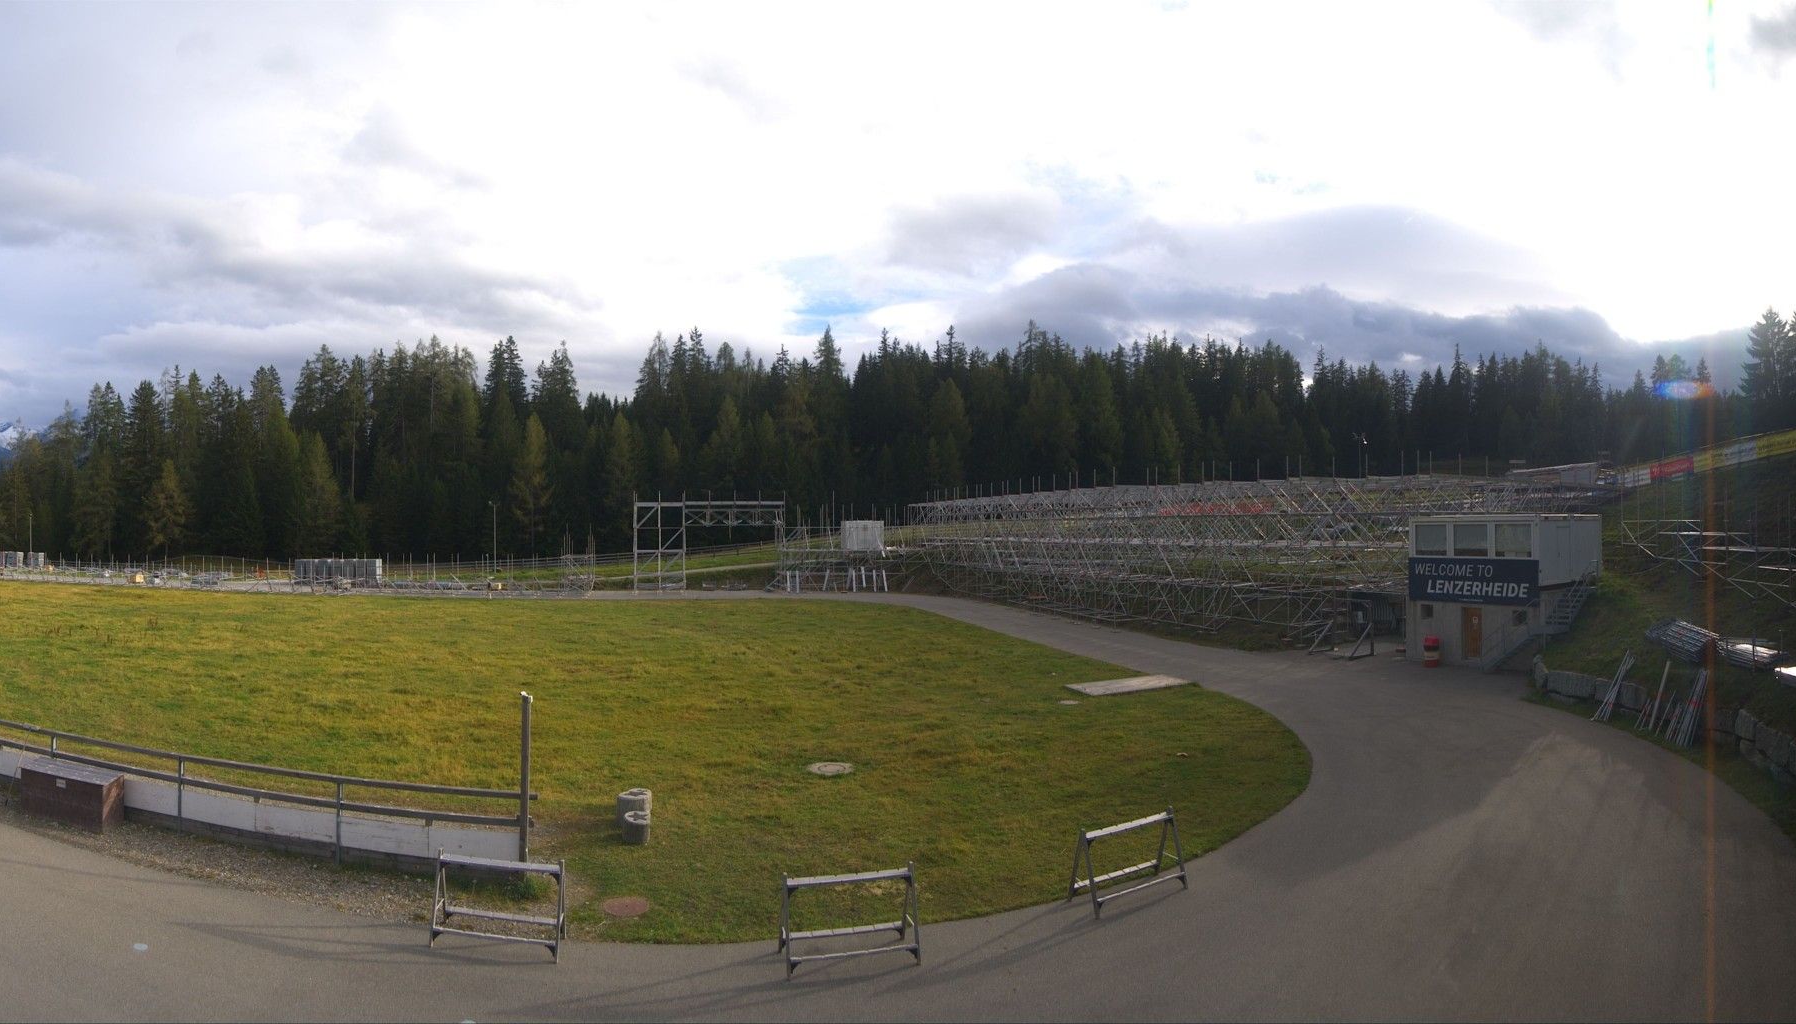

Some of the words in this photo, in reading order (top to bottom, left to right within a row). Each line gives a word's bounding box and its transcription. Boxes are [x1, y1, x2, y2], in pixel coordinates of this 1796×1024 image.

[1415, 562, 1473, 577] WELCOME
[1478, 564, 1493, 577] TO
[1427, 579, 1529, 598] LENZERHEIDE
